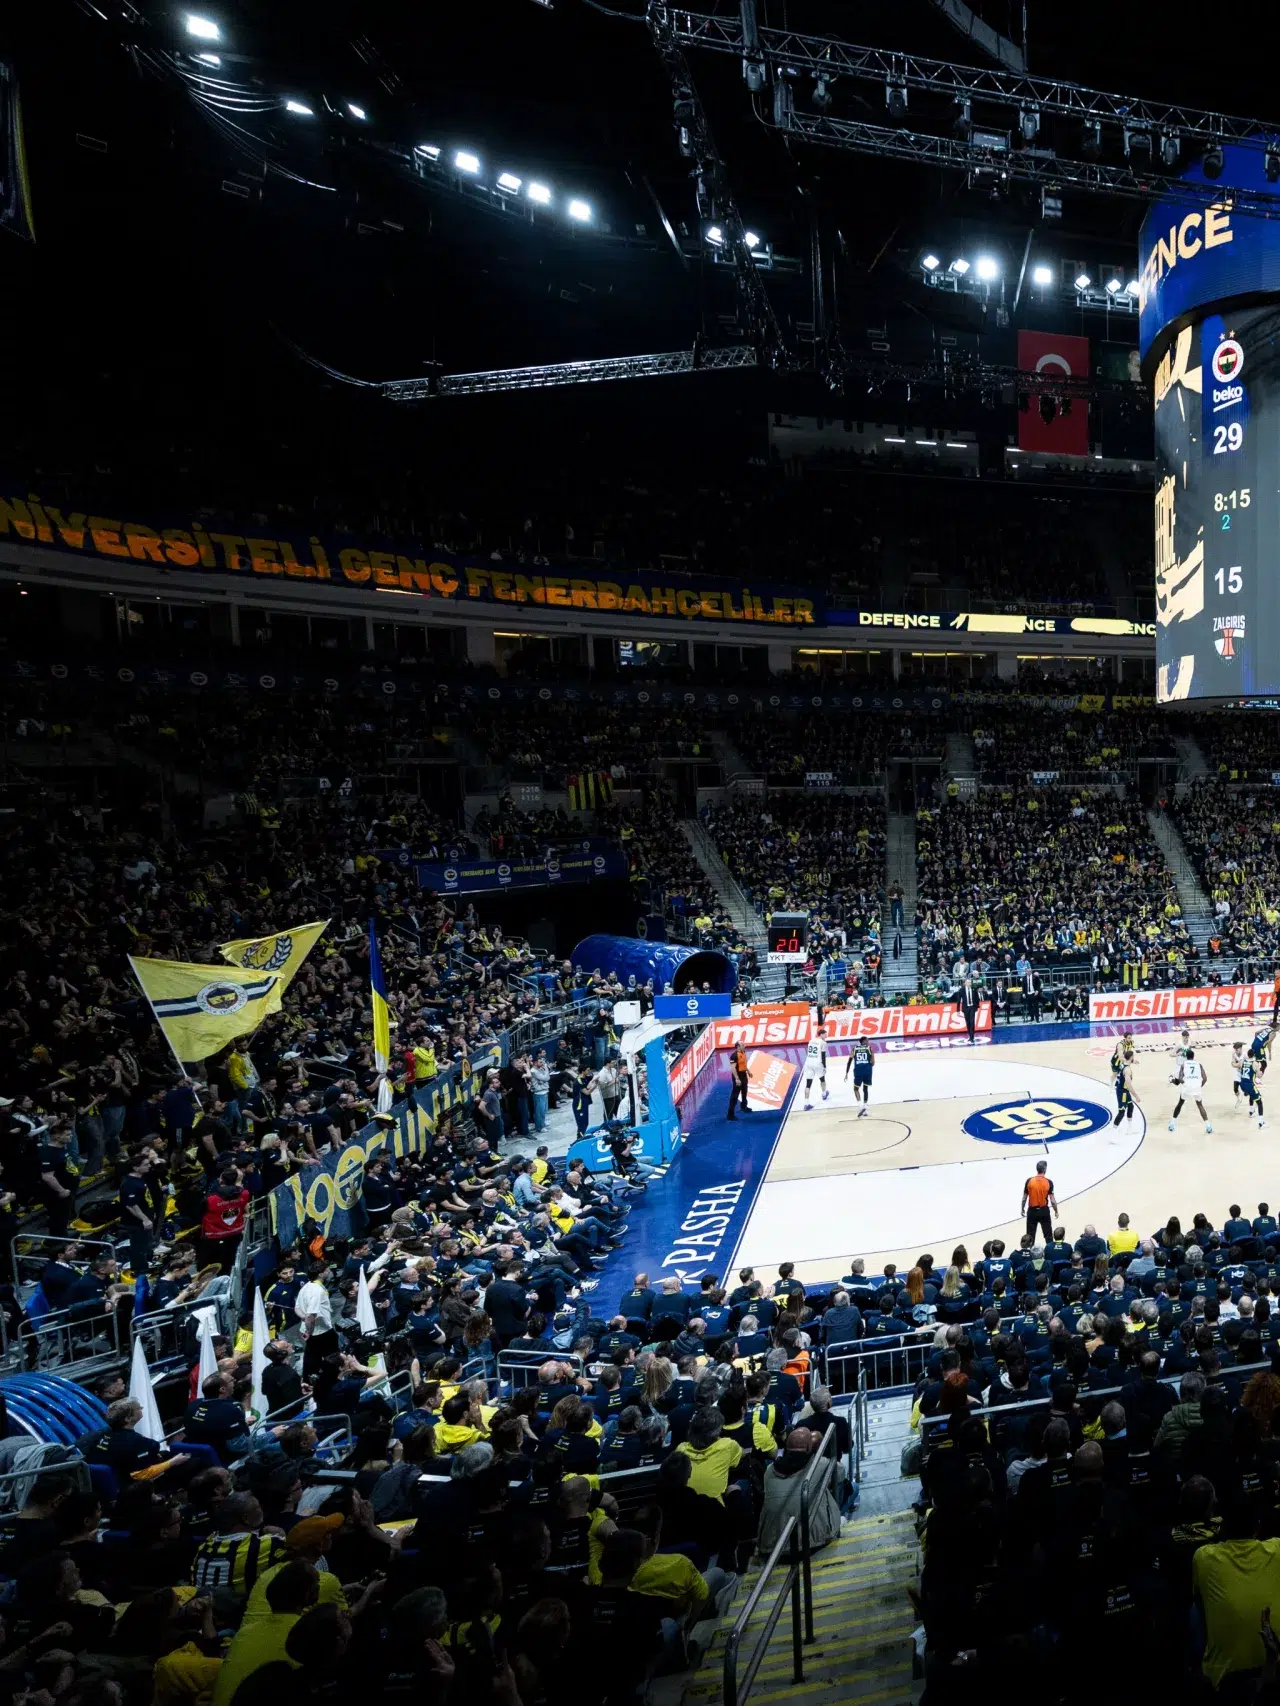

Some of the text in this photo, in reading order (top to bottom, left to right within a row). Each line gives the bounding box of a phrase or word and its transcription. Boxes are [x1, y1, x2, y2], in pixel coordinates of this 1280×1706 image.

[1212, 385, 1244, 403] beko
[1212, 422, 1244, 455] 29
[1213, 489, 1251, 513] 8:15
[1221, 514, 1231, 531] 2
[340, 546, 459, 598] GENÇ
[465, 566, 817, 625] FENERBAHÇELİLER
[1214, 566, 1244, 596] 15
[858, 612, 941, 629] DEFENCE
[1212, 615, 1246, 632] ZALGIRIS
[776, 938, 799, 953] 20
[1093, 992, 1172, 1019] misli
[1176, 987, 1252, 1017] misli
[715, 1015, 810, 1046] misli
[812, 1010, 901, 1038] misli
[903, 1001, 989, 1033] misi
[855, 1051, 868, 1061] 50
[670, 1056, 693, 1101] misli
[1189, 1066, 1195, 1075] 7
[660, 1179, 747, 1268] PASHA
